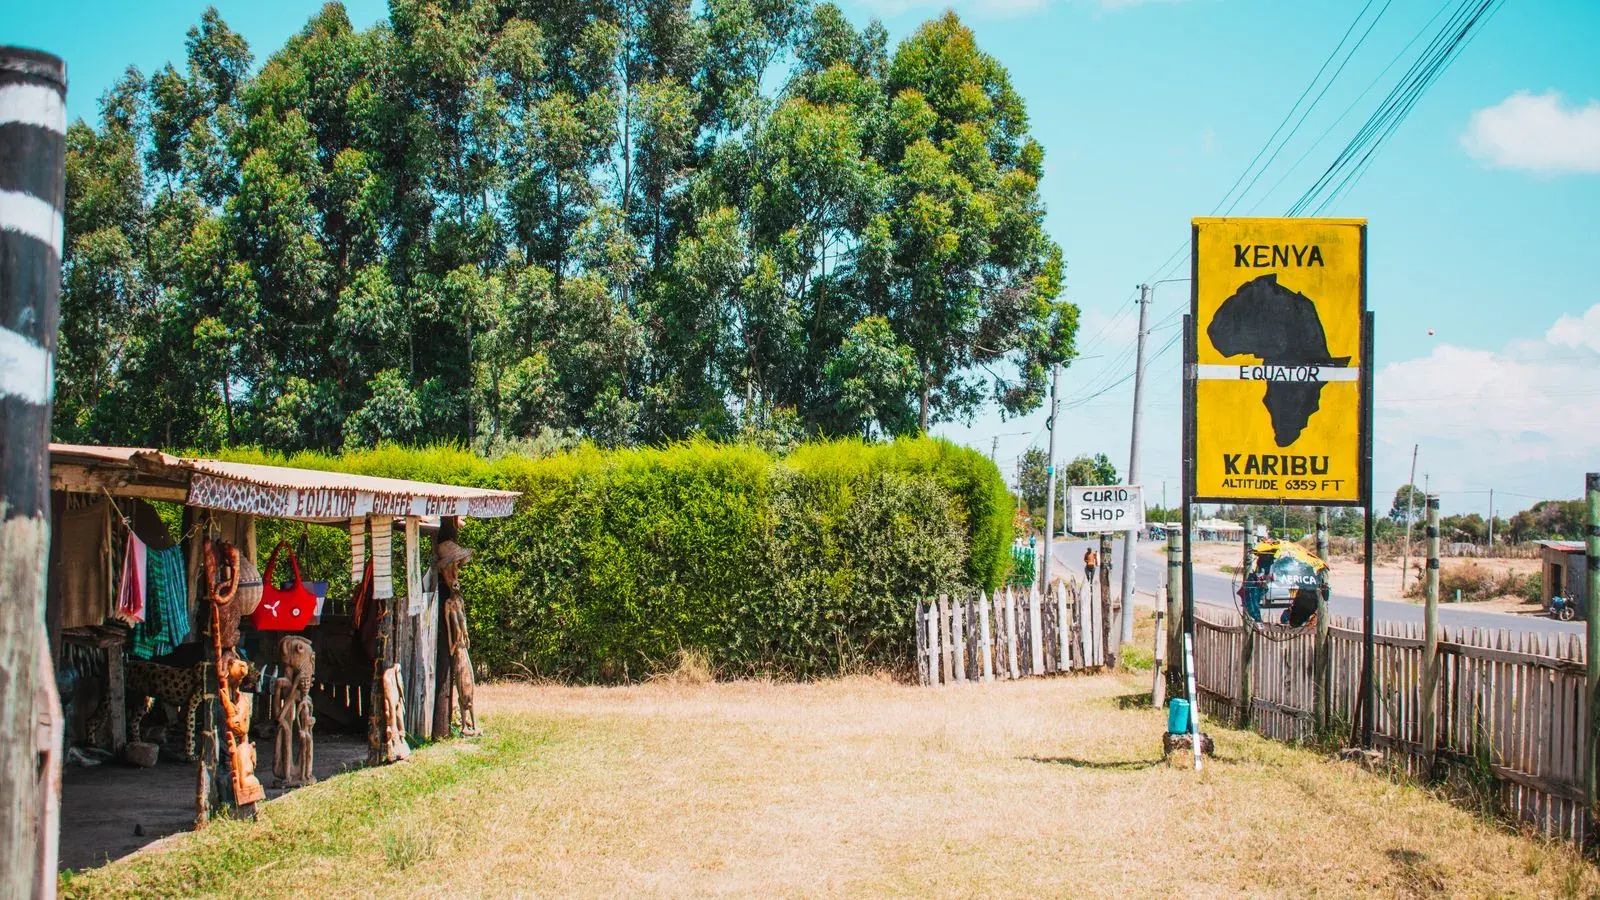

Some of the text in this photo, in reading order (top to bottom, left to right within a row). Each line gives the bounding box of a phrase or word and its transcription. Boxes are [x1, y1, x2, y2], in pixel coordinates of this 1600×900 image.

[1234, 244, 1324, 268] KENYA
[1240, 365, 1320, 382] EQUATOR
[1224, 453, 1329, 476] KARIBU
[1222, 478, 1344, 491] ALTITUDE 6359 FT
[295, 489, 356, 516] EQUATOR
[372, 492, 413, 516] GIRAFFE
[1083, 489, 1128, 502] CURIO
[1080, 508, 1125, 521] SHOP
